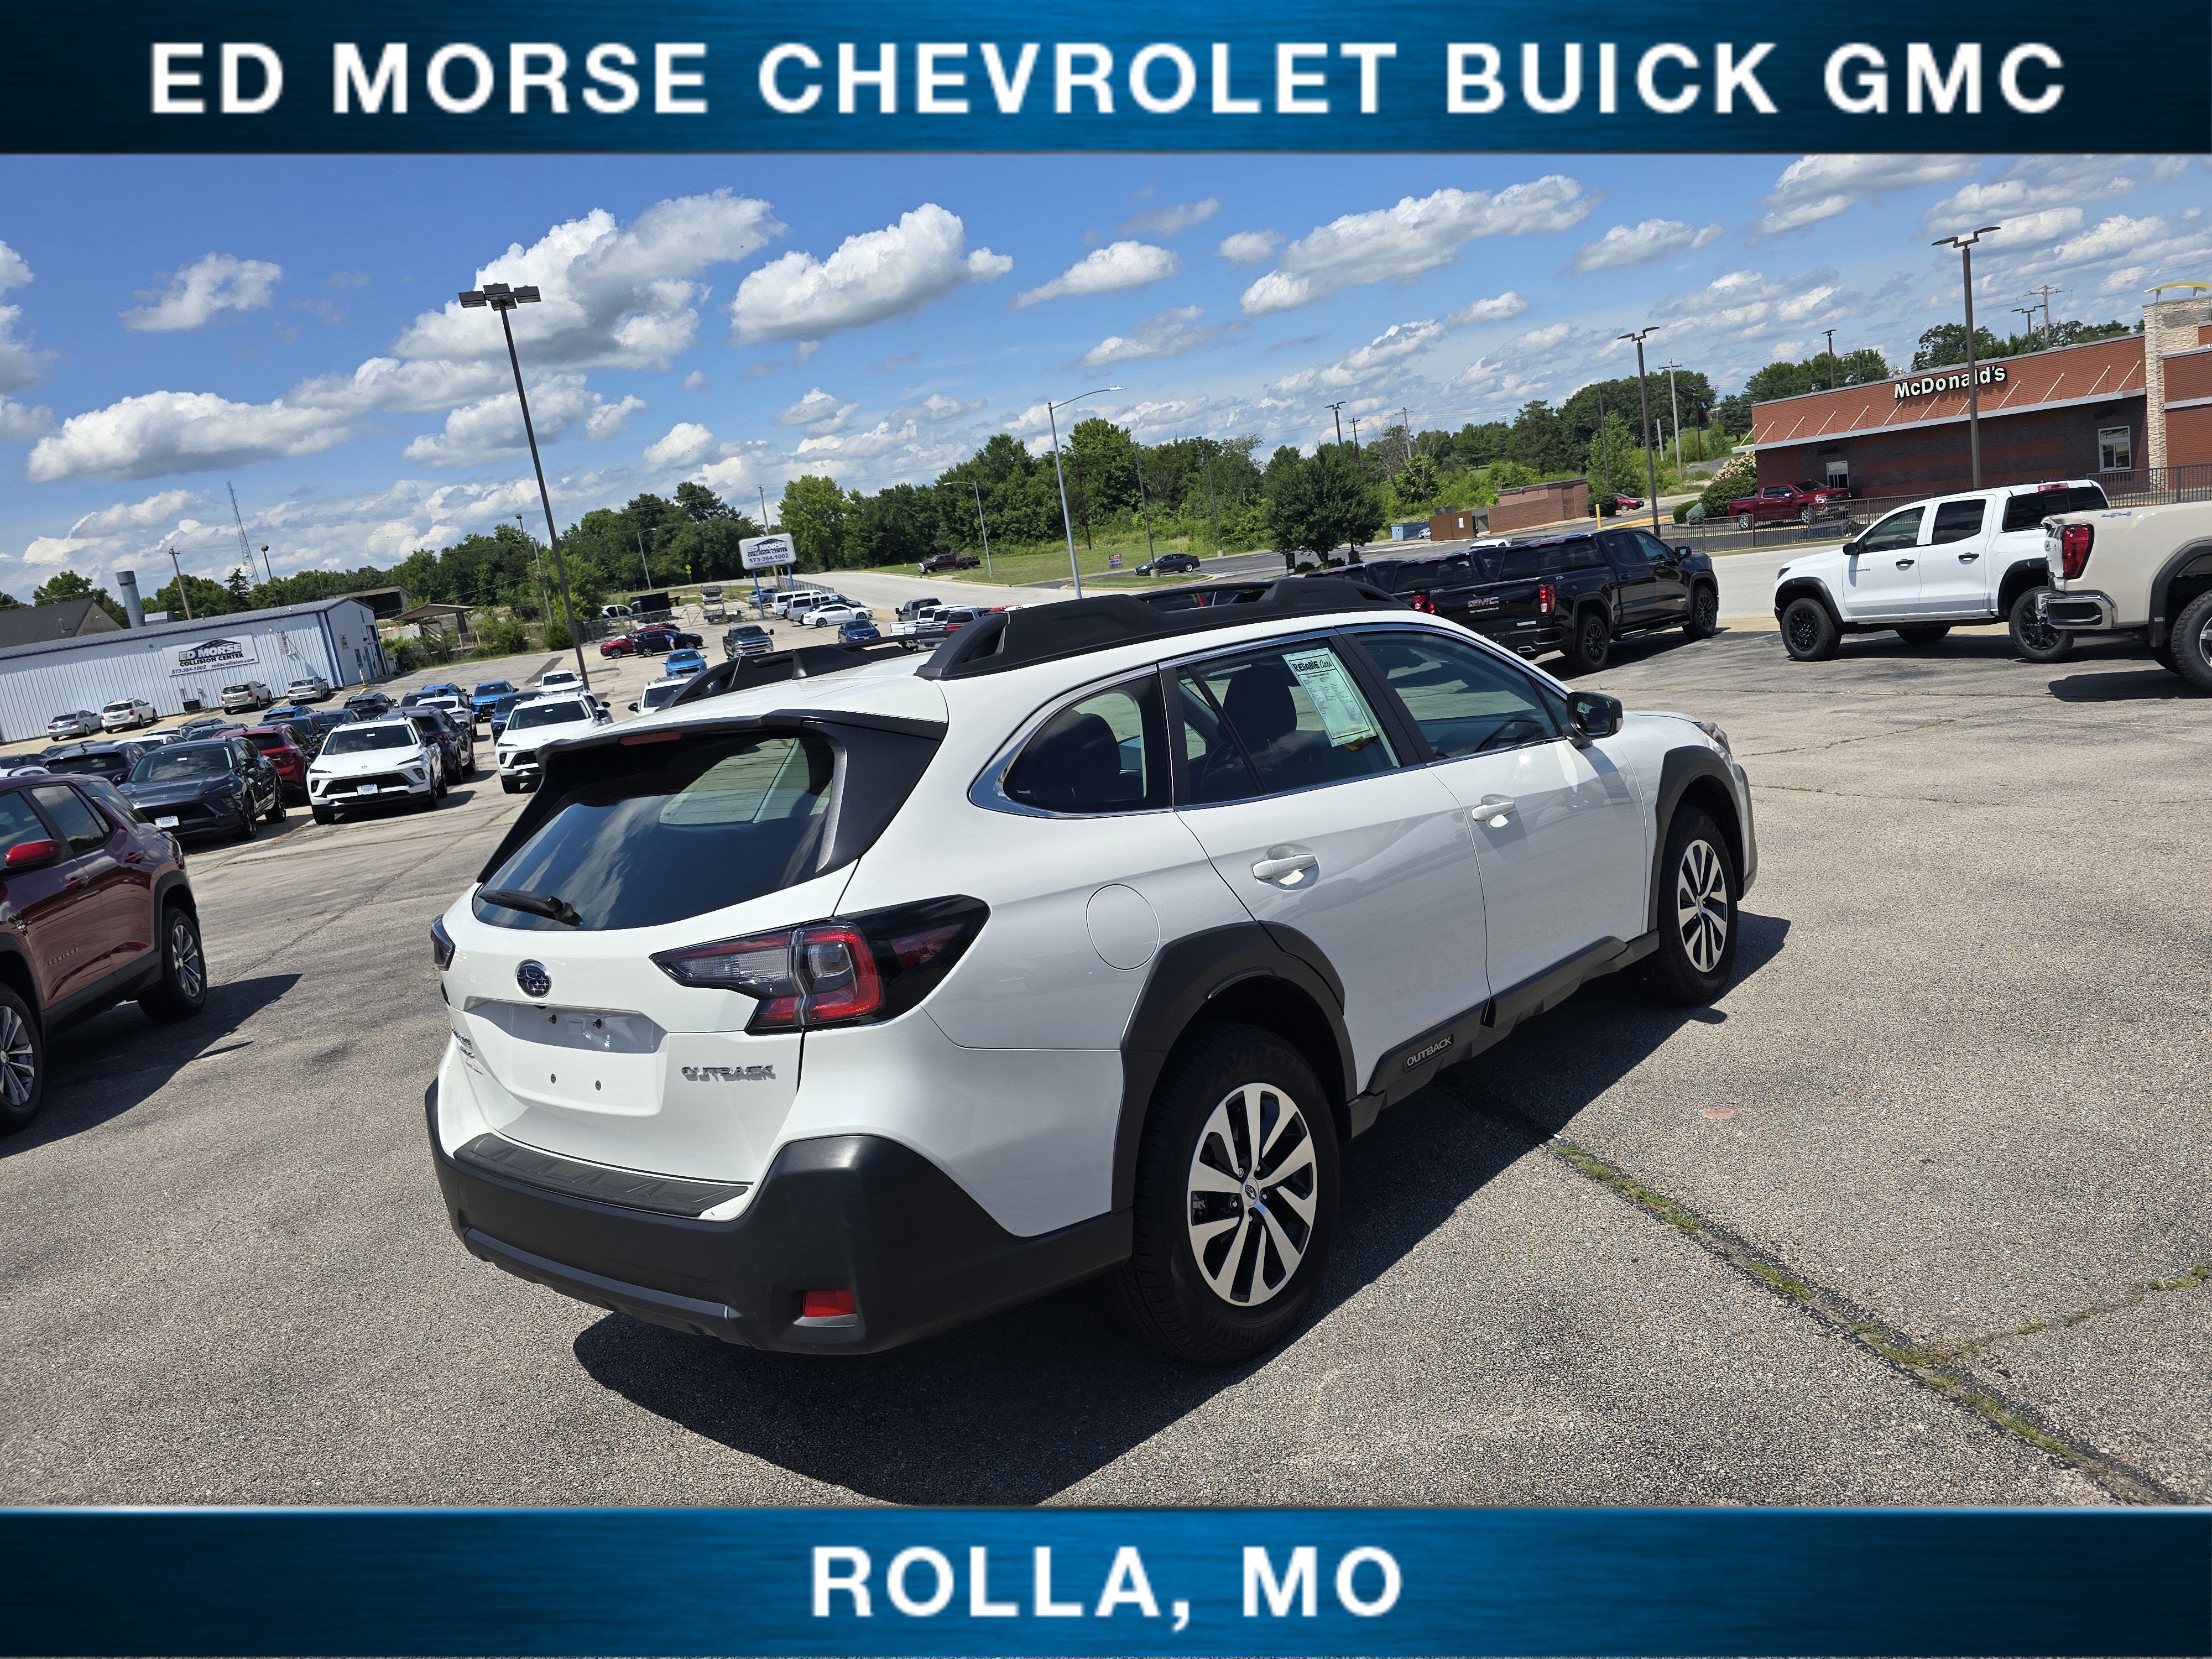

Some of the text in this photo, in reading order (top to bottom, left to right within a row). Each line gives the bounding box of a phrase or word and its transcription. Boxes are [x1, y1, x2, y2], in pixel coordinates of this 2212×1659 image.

[1895, 366, 2005, 399] McDonald's
[759, 541, 786, 551] MORSE
[749, 554, 789, 563] 573-364-1002
[1468, 596, 1499, 607] GMC
[179, 643, 242, 661] ED MORSE
[171, 658, 255, 674] 573-364-1002 rollacollision.com
[180, 656, 217, 667] COLLISION
[1406, 1036, 1452, 1066] OUTBACK
[681, 1065, 773, 1077] OUTBACK
